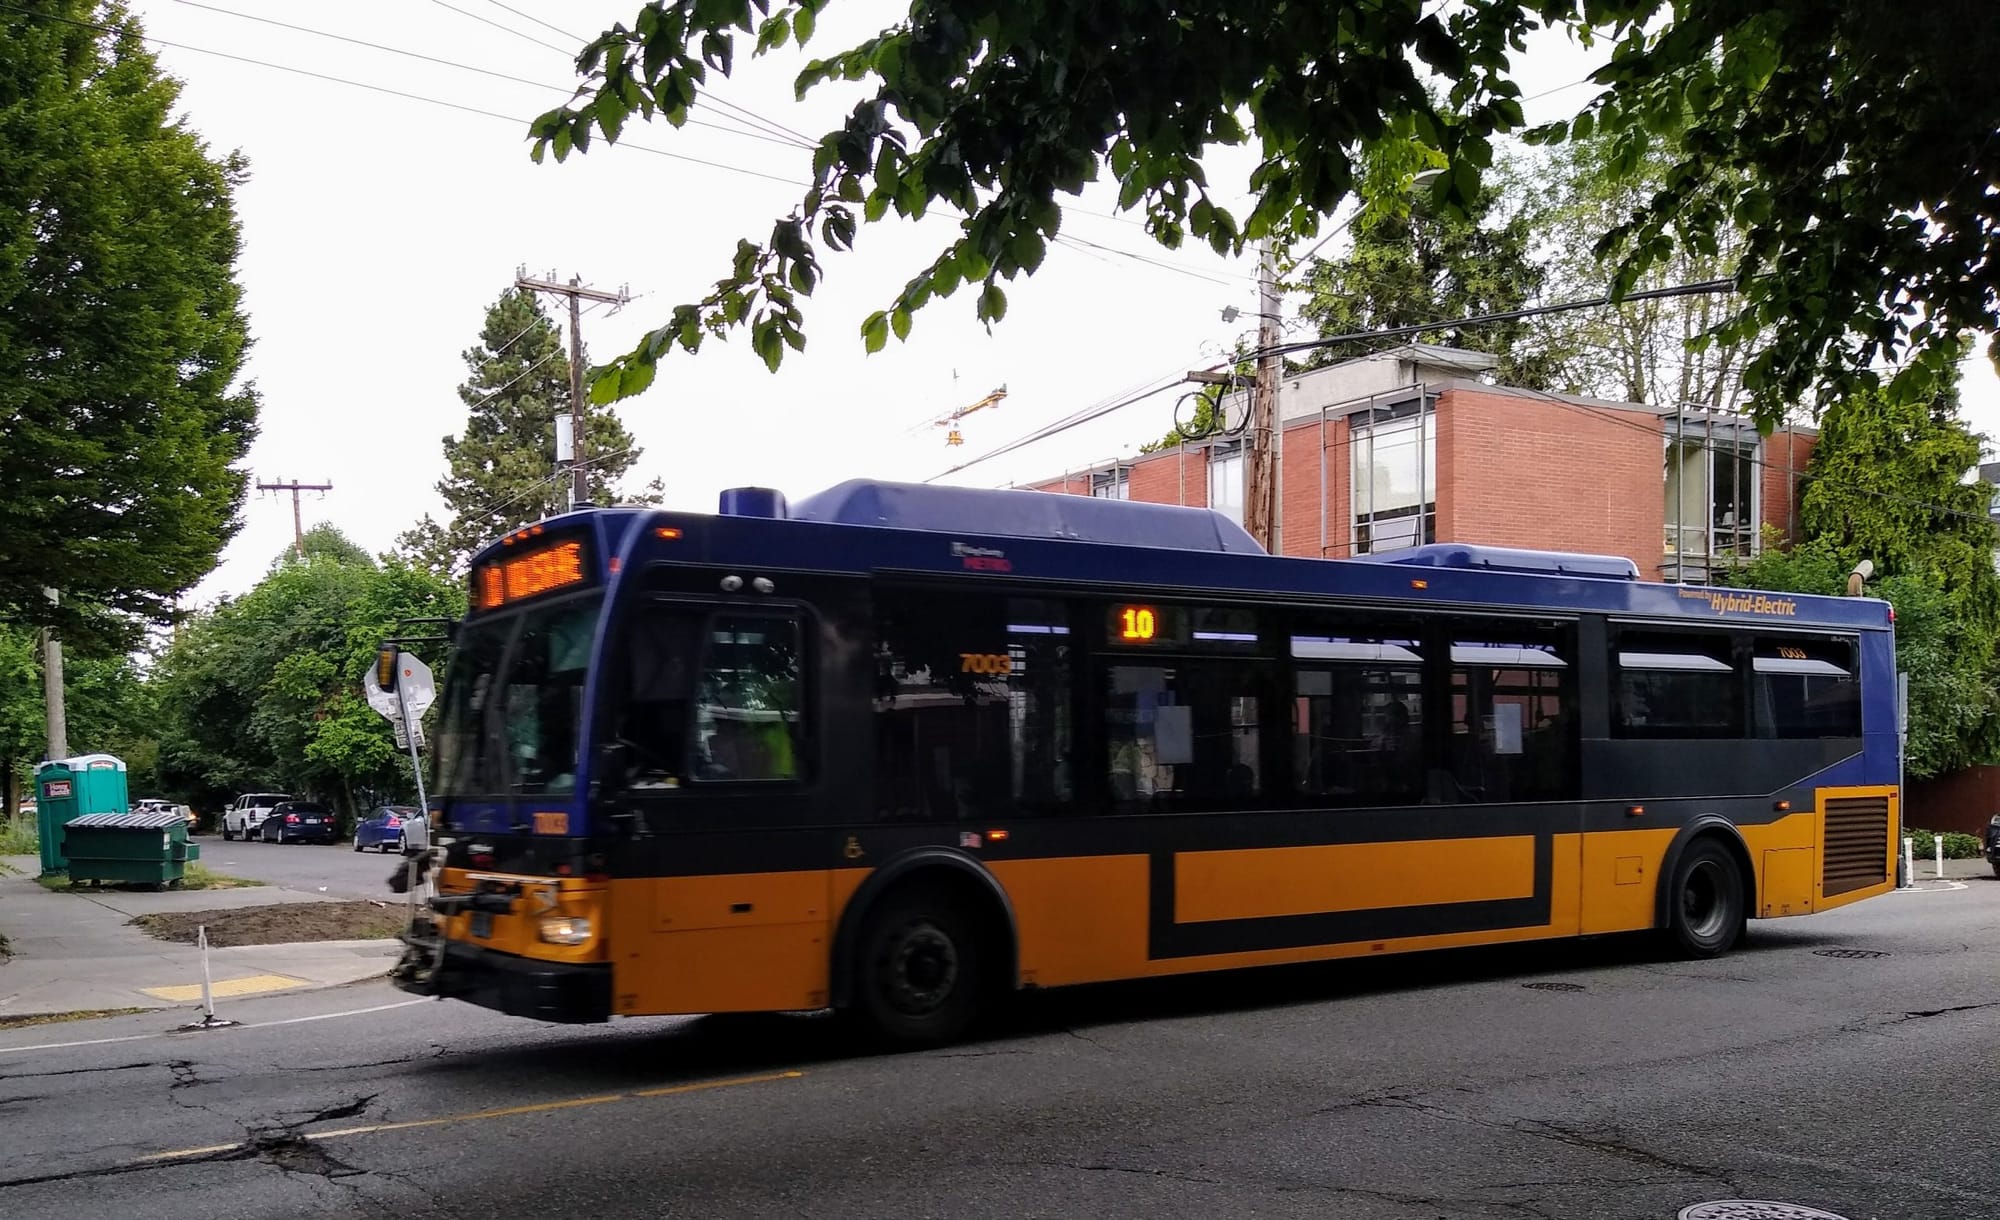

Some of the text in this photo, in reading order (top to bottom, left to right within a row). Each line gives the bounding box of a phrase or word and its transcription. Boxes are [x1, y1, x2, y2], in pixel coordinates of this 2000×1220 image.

[1711, 593, 1796, 616] Hybrid-Electric
[1122, 609, 1154, 639] 10
[960, 653, 1012, 673] 7003
[1777, 647, 1806, 659] 7003
